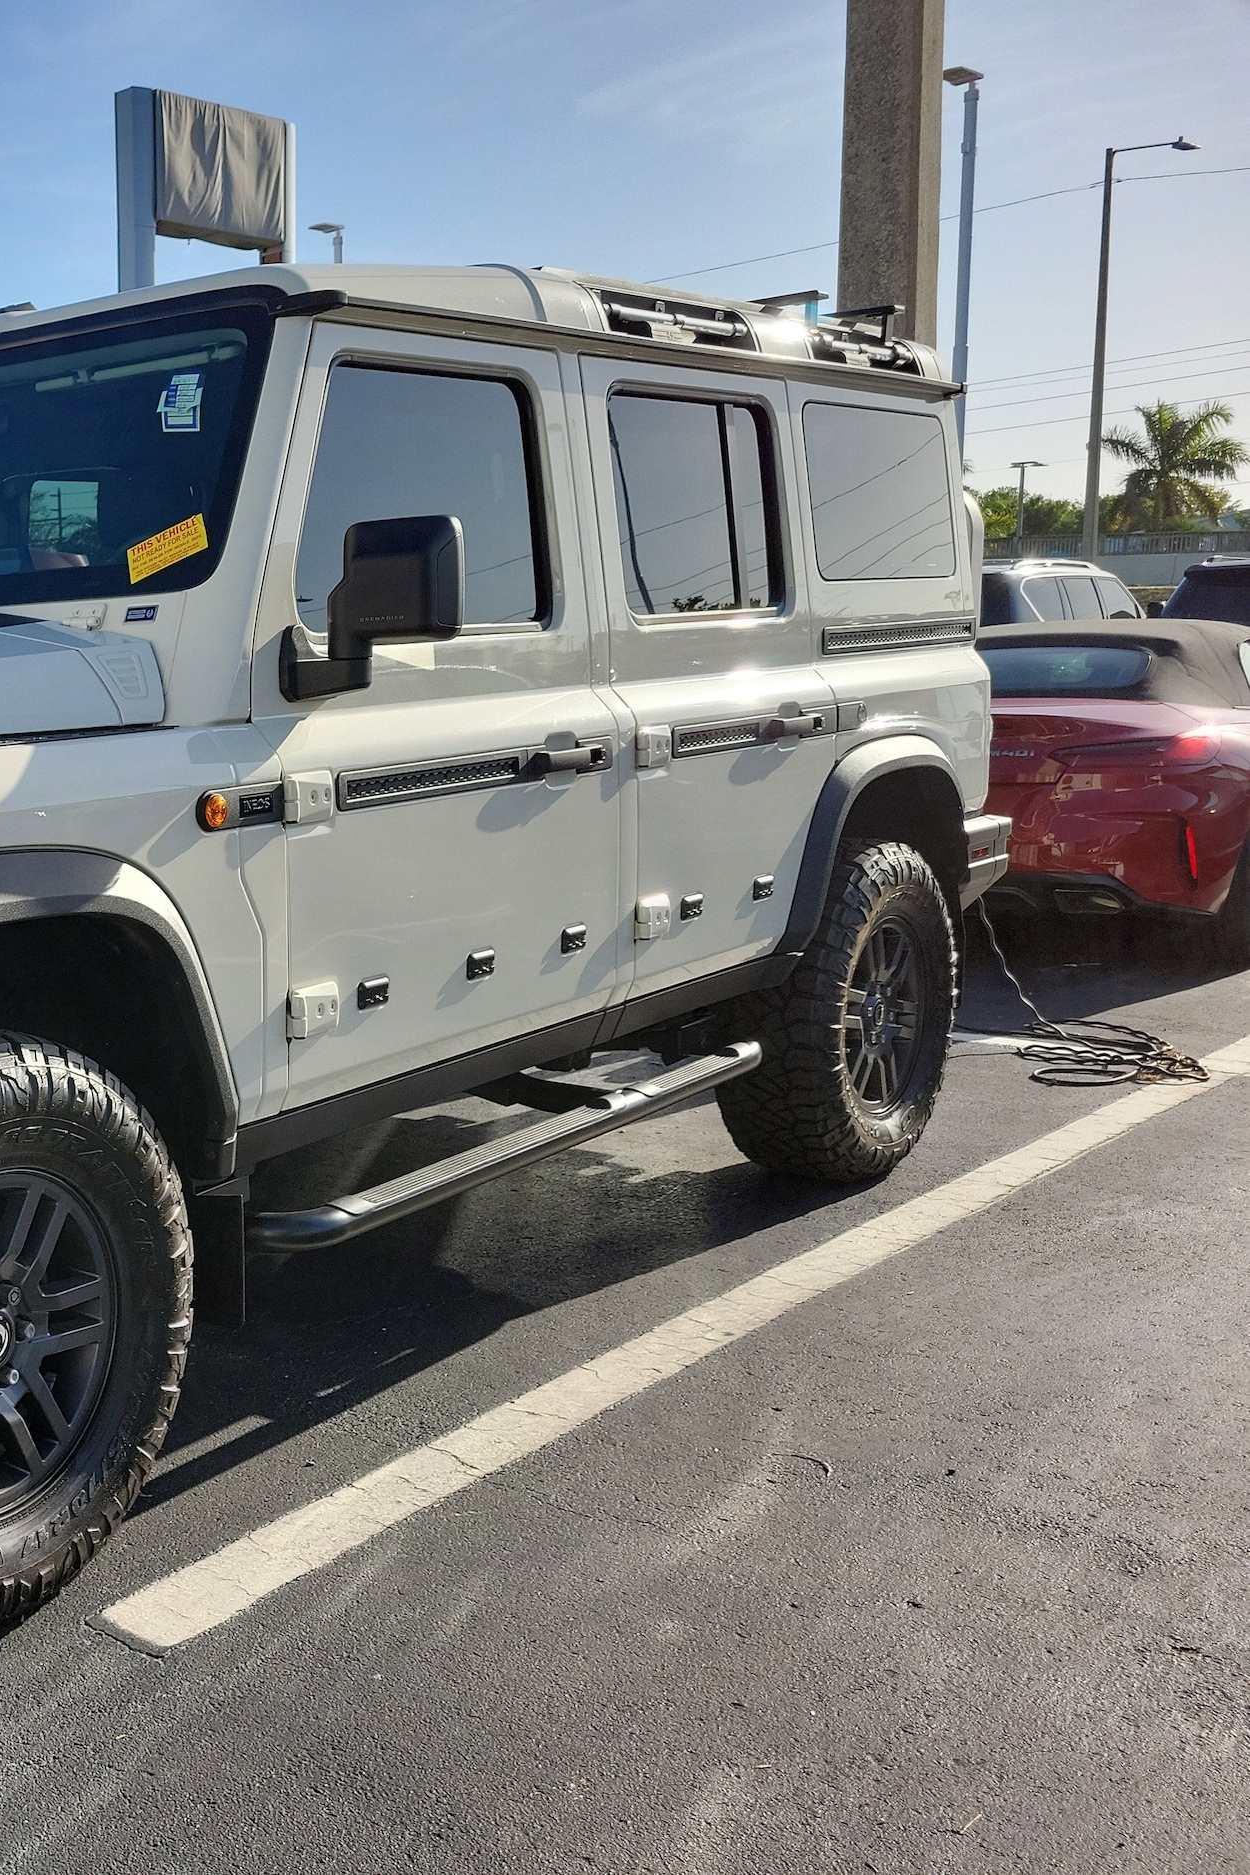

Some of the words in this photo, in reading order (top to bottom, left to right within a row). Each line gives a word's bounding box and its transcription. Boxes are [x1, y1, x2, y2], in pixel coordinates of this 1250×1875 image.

[131, 539, 153, 556] THIS
[155, 516, 198, 543] VEHICLE
[132, 553, 144, 564] NOT
[146, 542, 167, 557] READY
[167, 535, 181, 546] FOR
[182, 526, 199, 540] SALE
[359, 615, 405, 623] GRENADIER
[243, 797, 271, 813] INEOS
